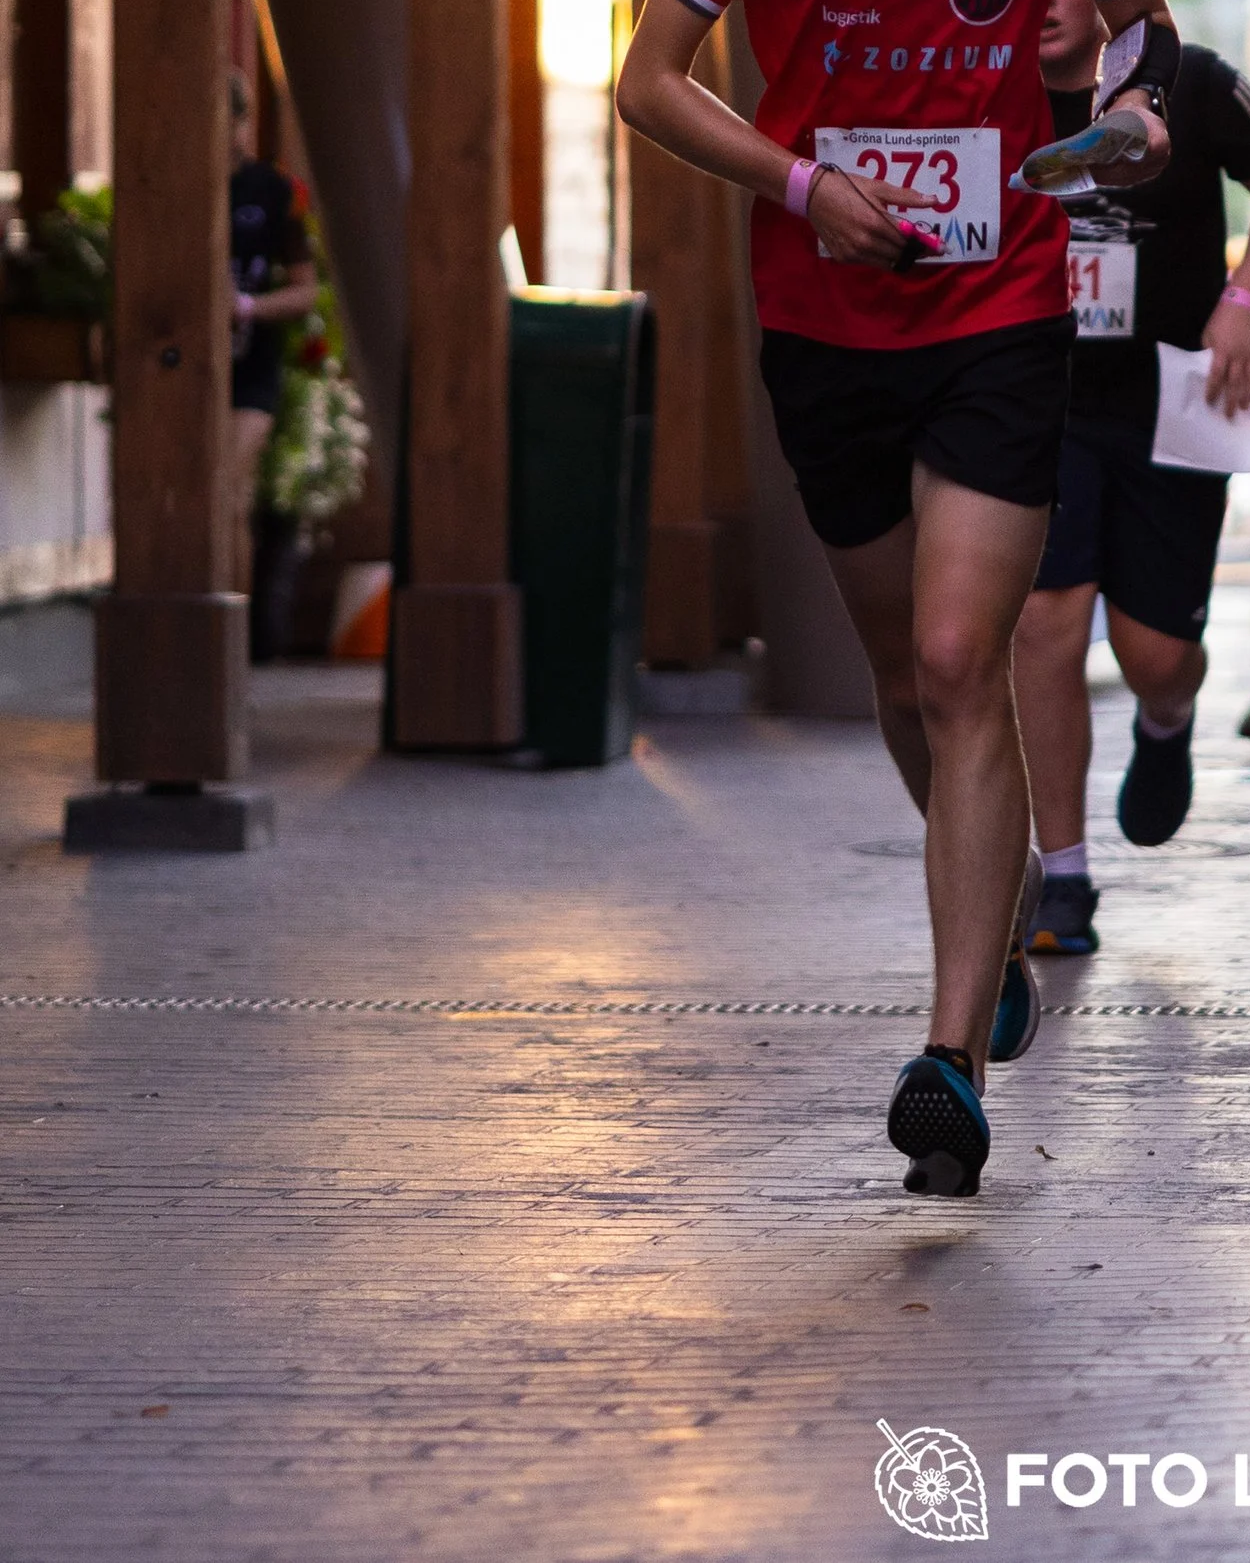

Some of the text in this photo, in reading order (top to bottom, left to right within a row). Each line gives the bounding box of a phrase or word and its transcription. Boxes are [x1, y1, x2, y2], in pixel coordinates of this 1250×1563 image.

[822, 5, 881, 28] logistik
[863, 45, 1012, 71] ZOZIUM
[849, 132, 960, 146] Gröna Lund-sprinten
